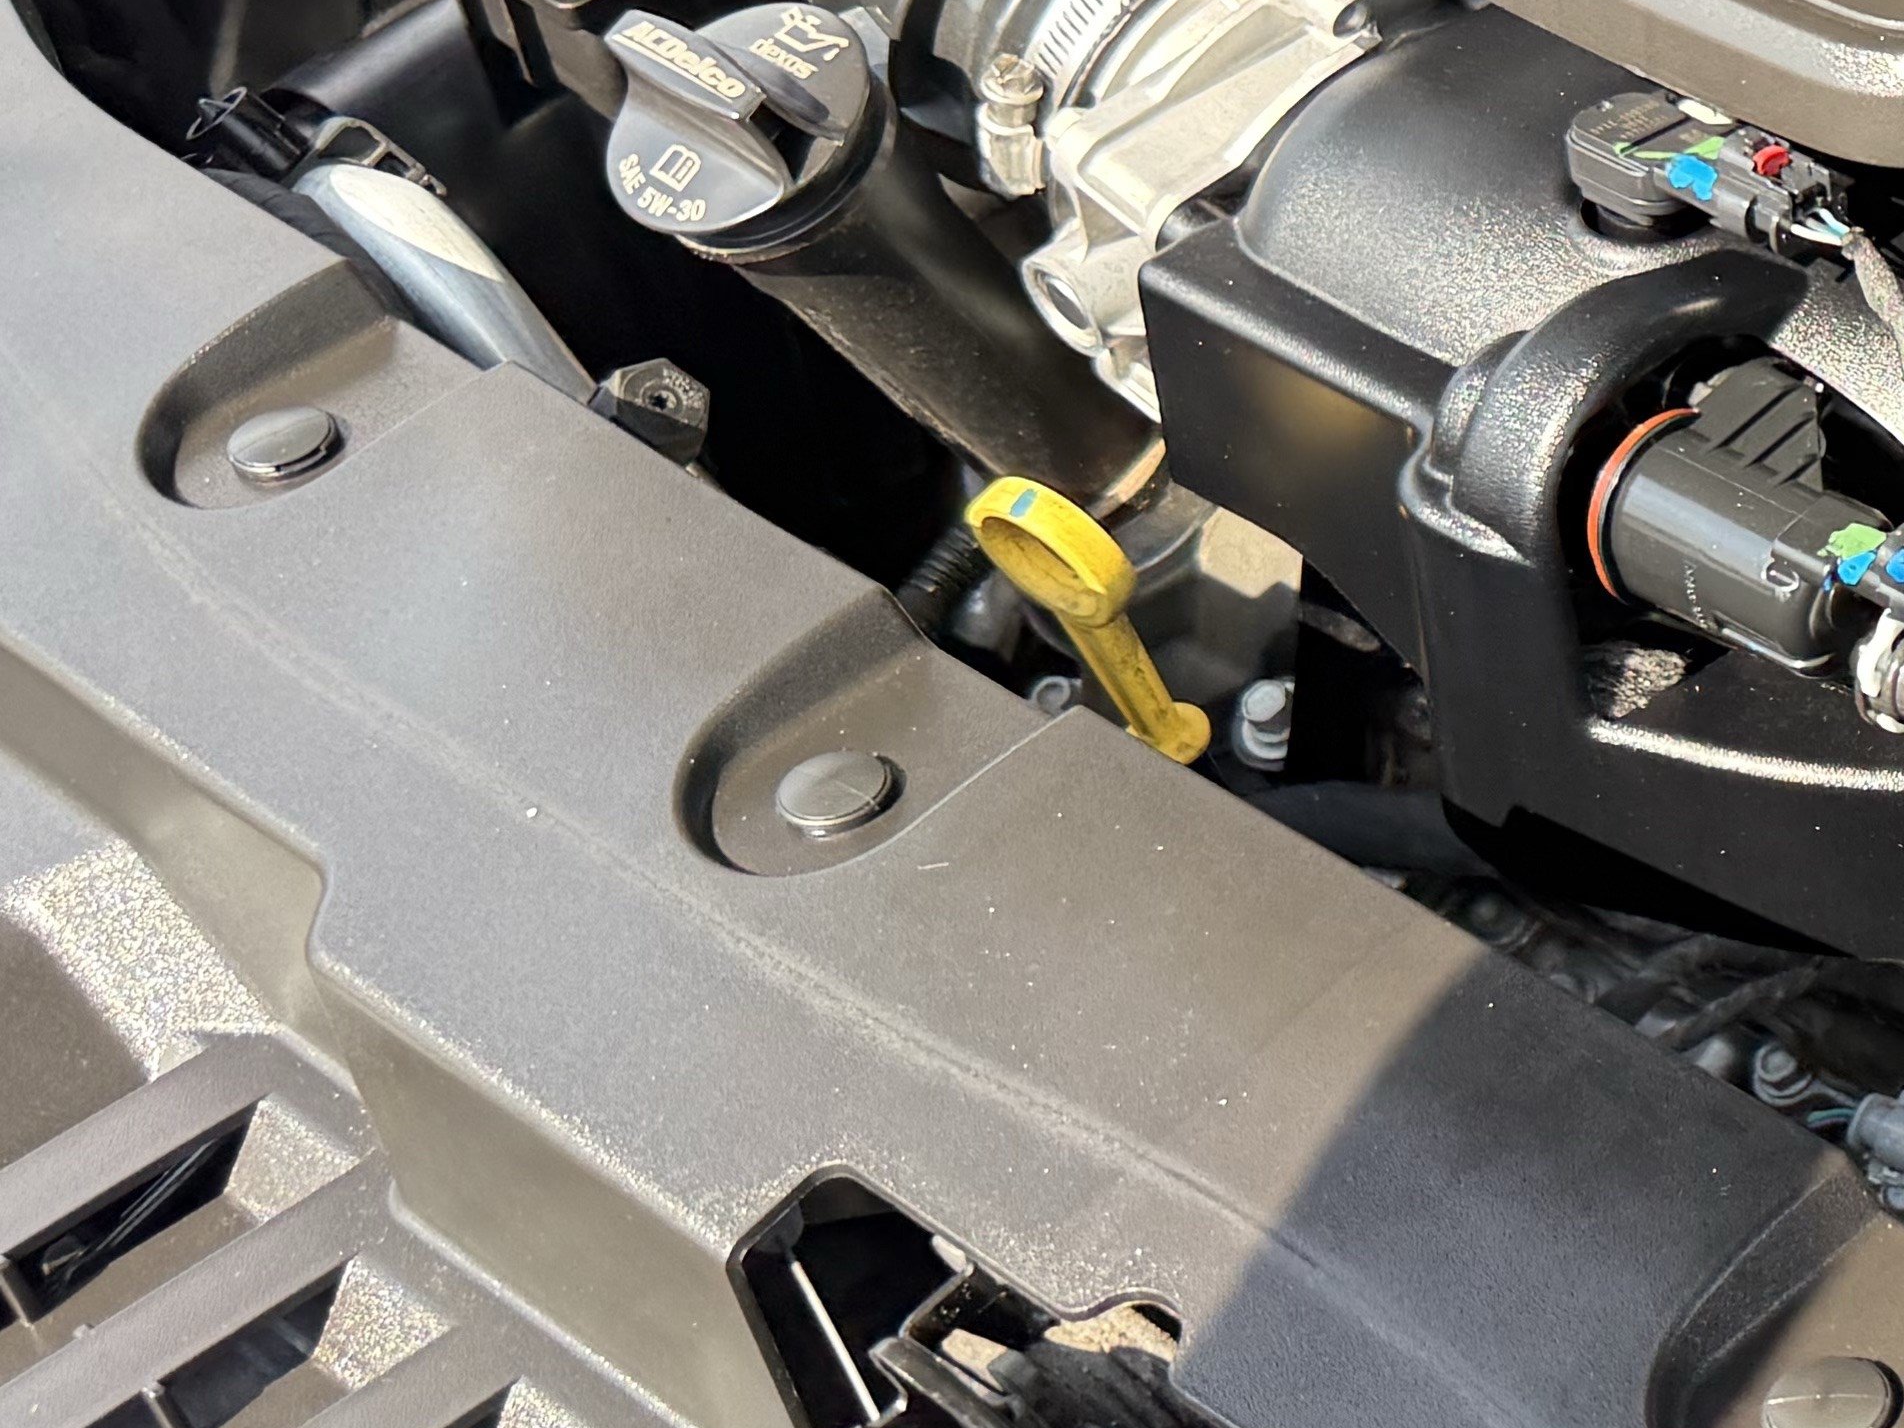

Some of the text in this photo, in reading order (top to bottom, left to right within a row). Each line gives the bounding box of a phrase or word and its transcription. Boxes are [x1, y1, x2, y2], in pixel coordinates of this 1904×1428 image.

[618, 20, 747, 99] ACDelco
[749, 37, 819, 80] dexos
[618, 153, 707, 222] SAE 5W-30
